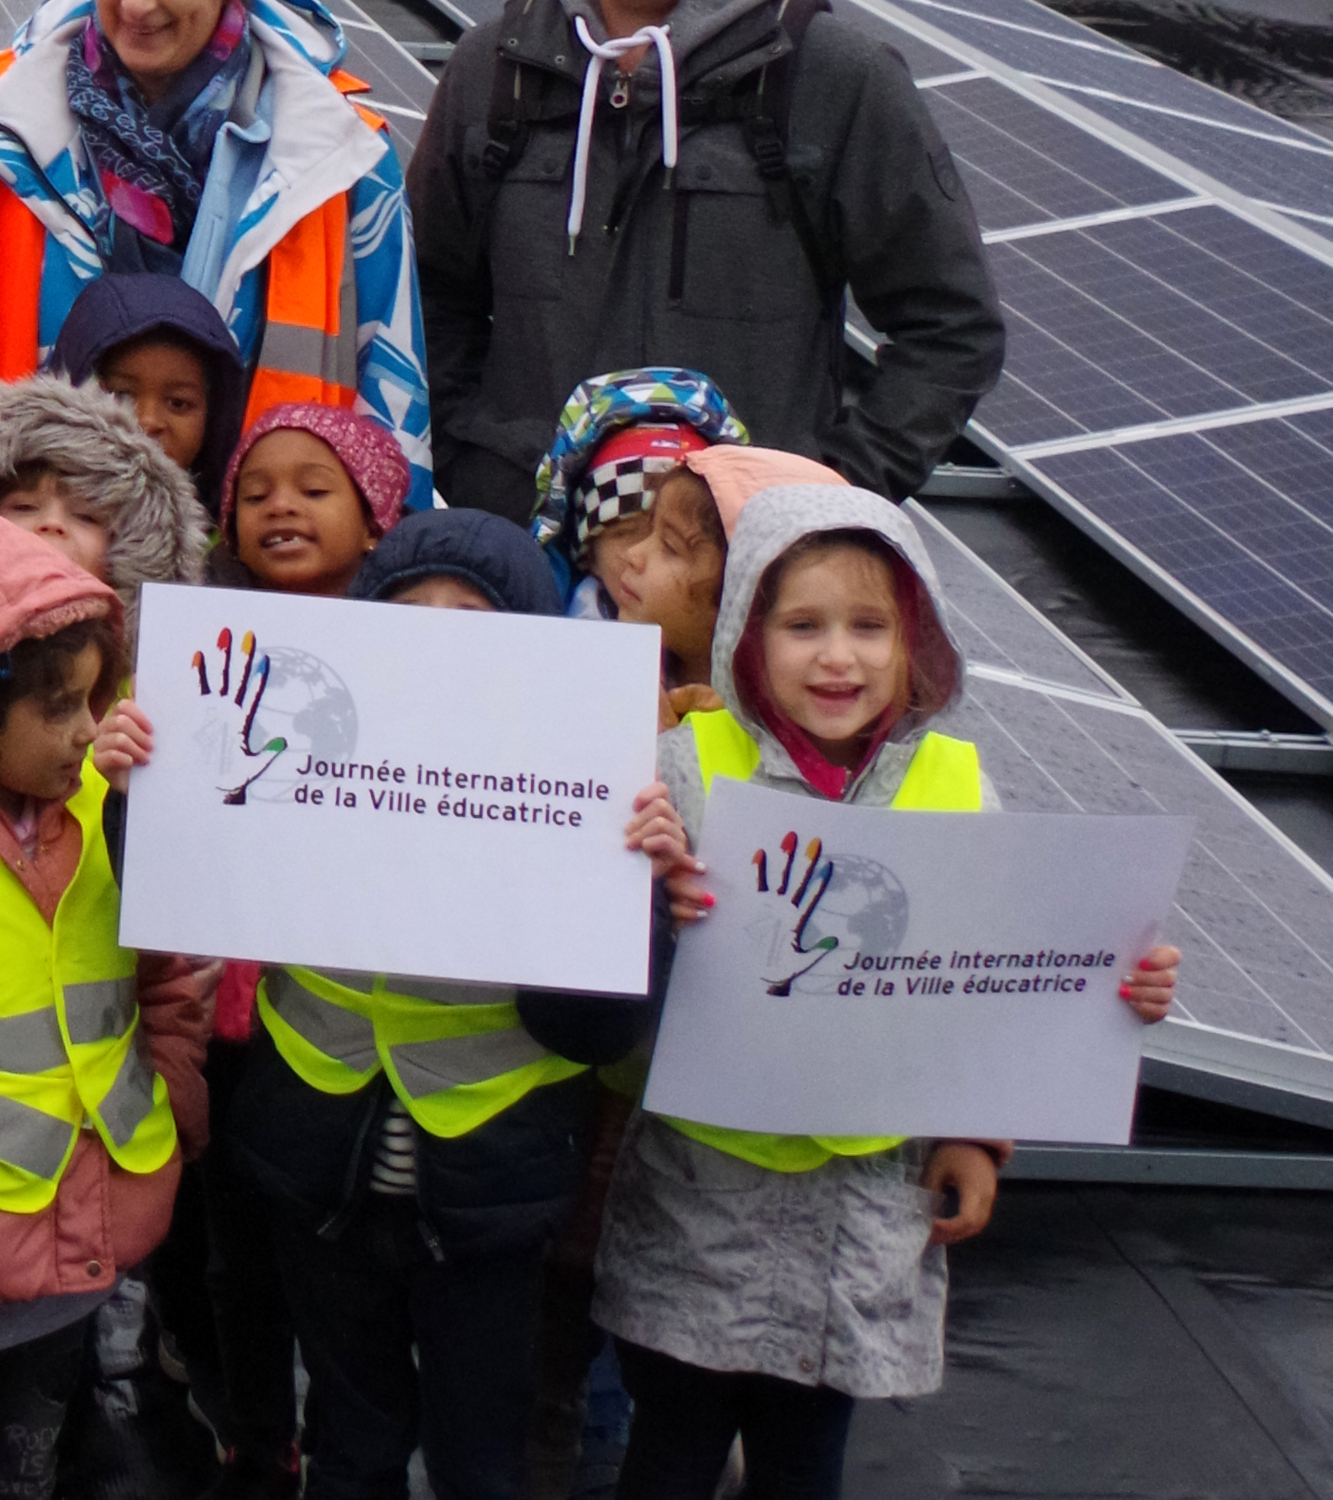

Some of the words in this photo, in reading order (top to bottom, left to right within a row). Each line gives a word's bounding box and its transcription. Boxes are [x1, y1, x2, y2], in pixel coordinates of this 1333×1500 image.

[295, 754, 407, 784] Journée
[416, 764, 610, 801] internationale
[294, 784, 325, 805] de
[334, 787, 358, 808] la
[369, 789, 427, 815] Ville
[436, 794, 583, 827] éducatrice
[843, 950, 942, 970] Journée
[949, 950, 1116, 969] internationale
[837, 978, 865, 996] de
[873, 978, 895, 996] la
[905, 976, 955, 996] Ville
[962, 974, 1087, 994] éducatrice
